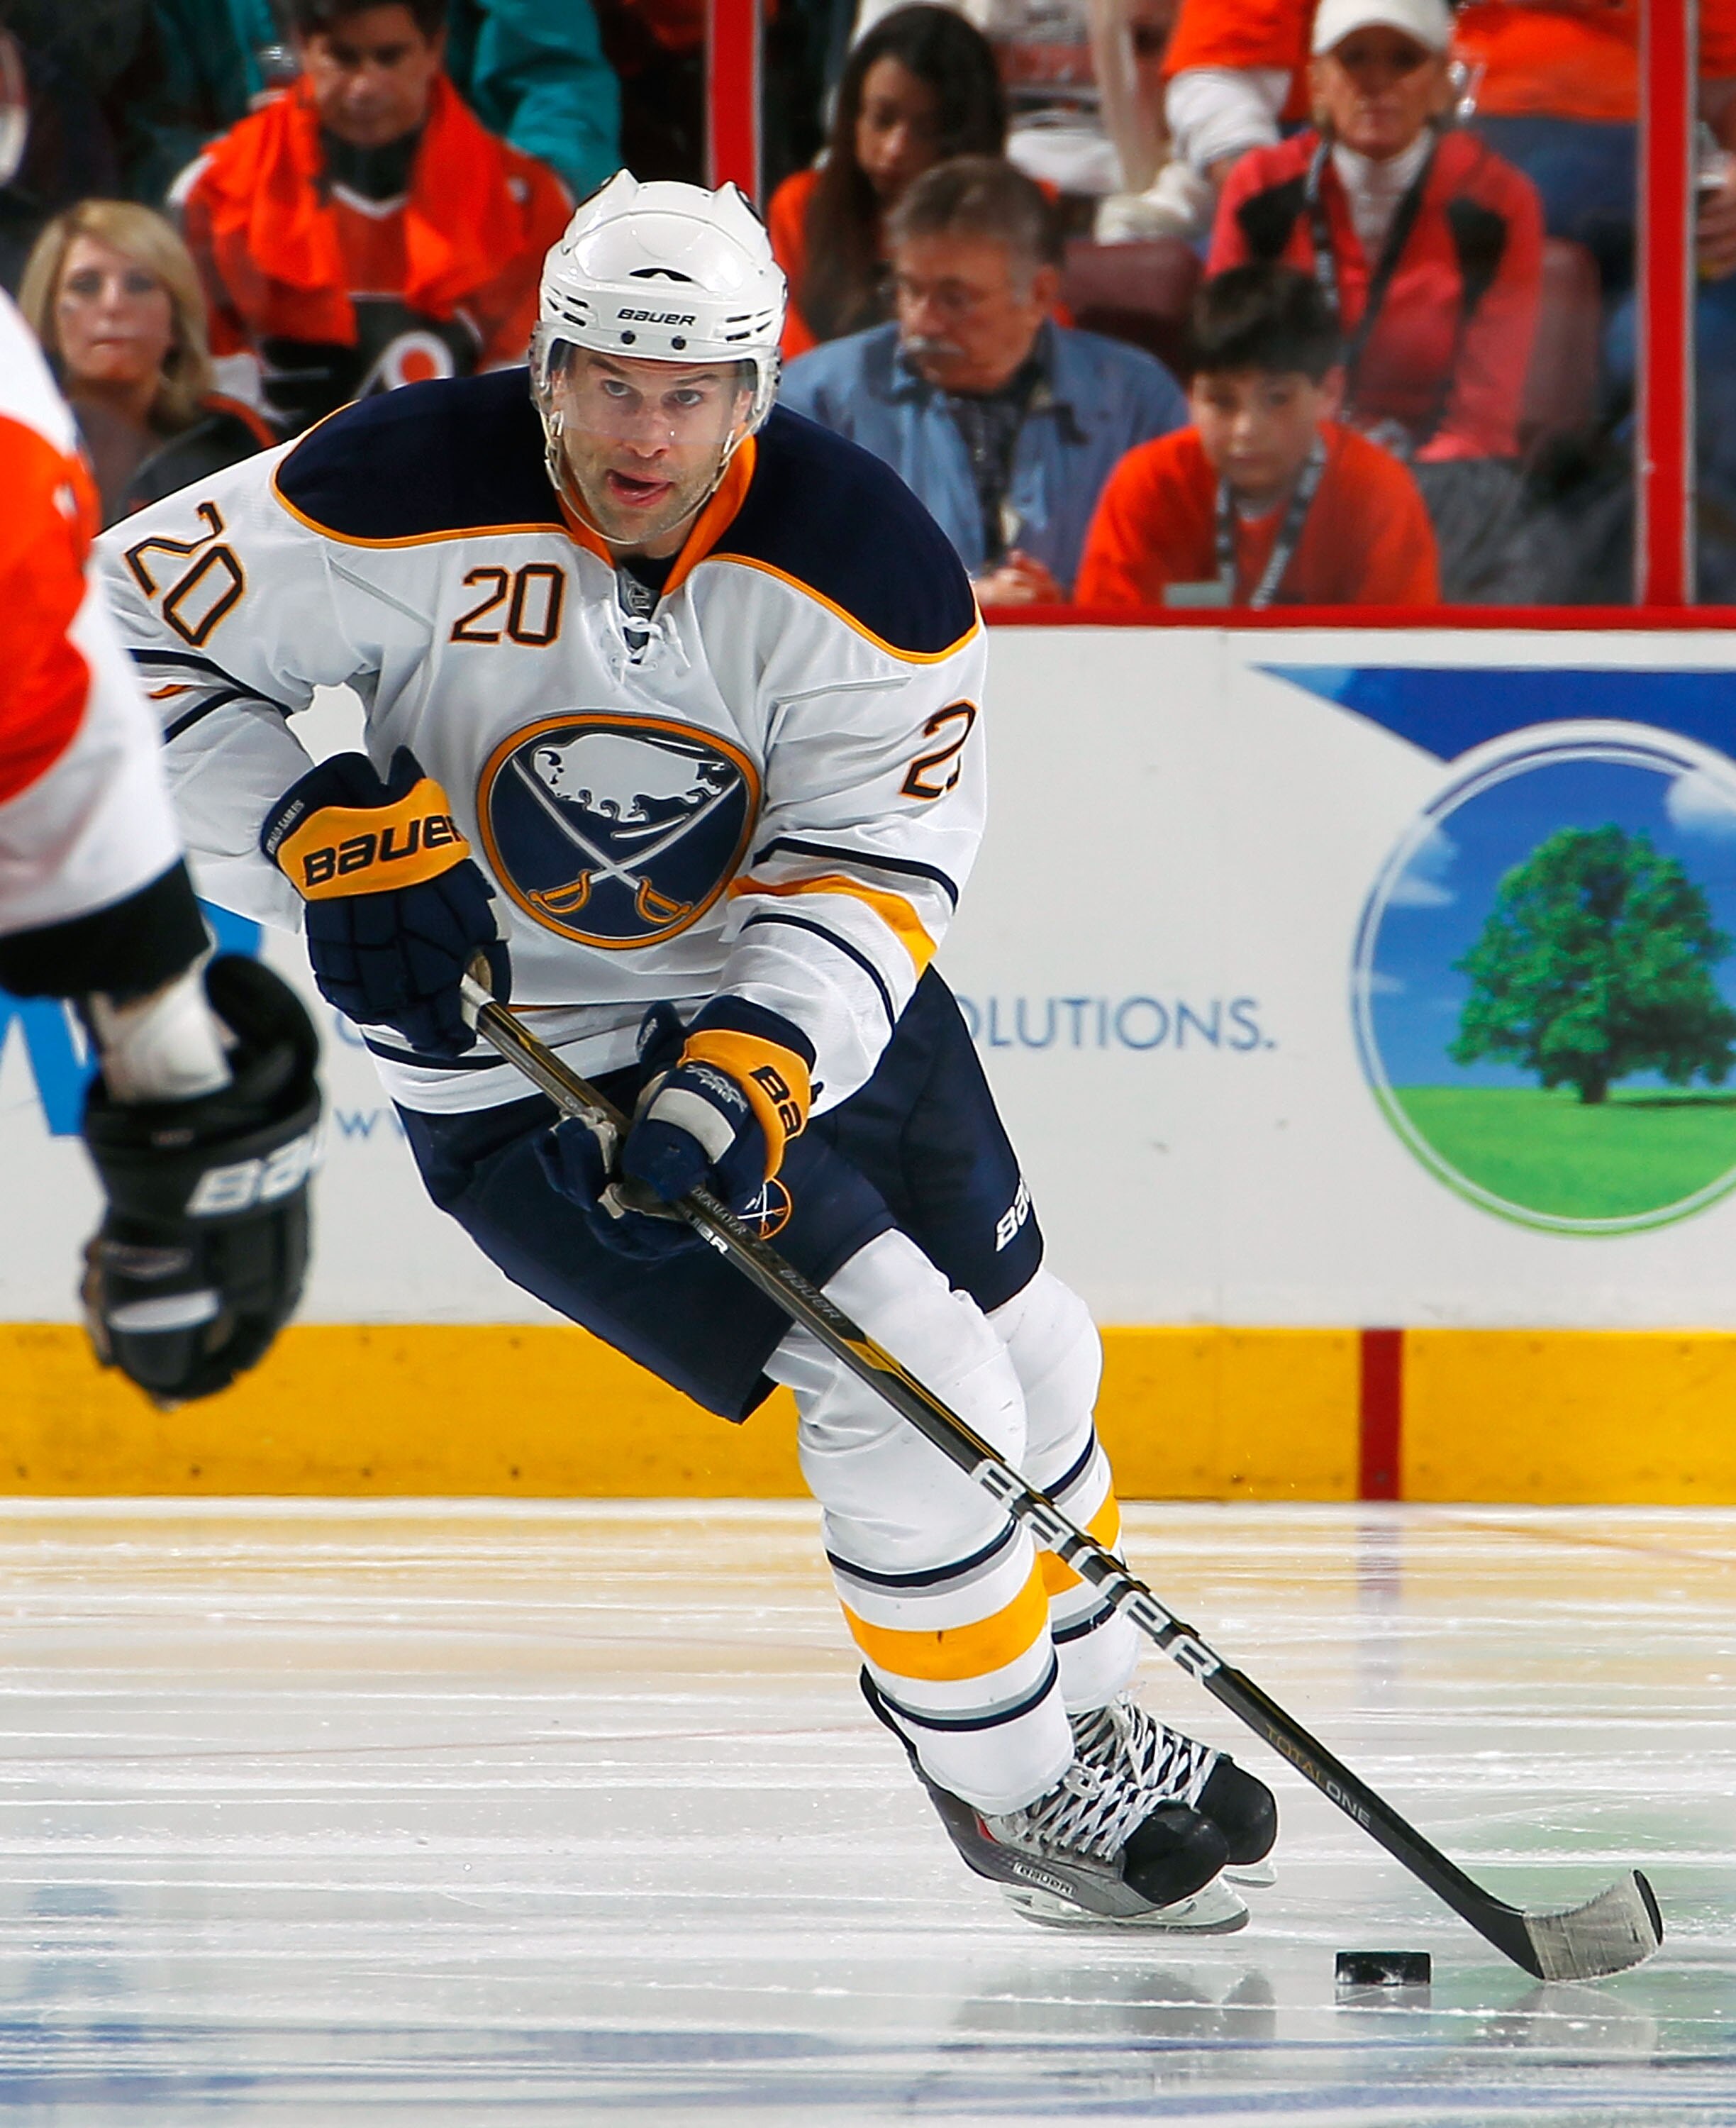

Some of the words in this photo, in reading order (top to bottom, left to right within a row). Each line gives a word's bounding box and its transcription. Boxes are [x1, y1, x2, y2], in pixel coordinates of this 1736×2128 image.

[123, 501, 245, 648] 20
[450, 563, 566, 648] 20
[898, 699, 979, 802] 2
